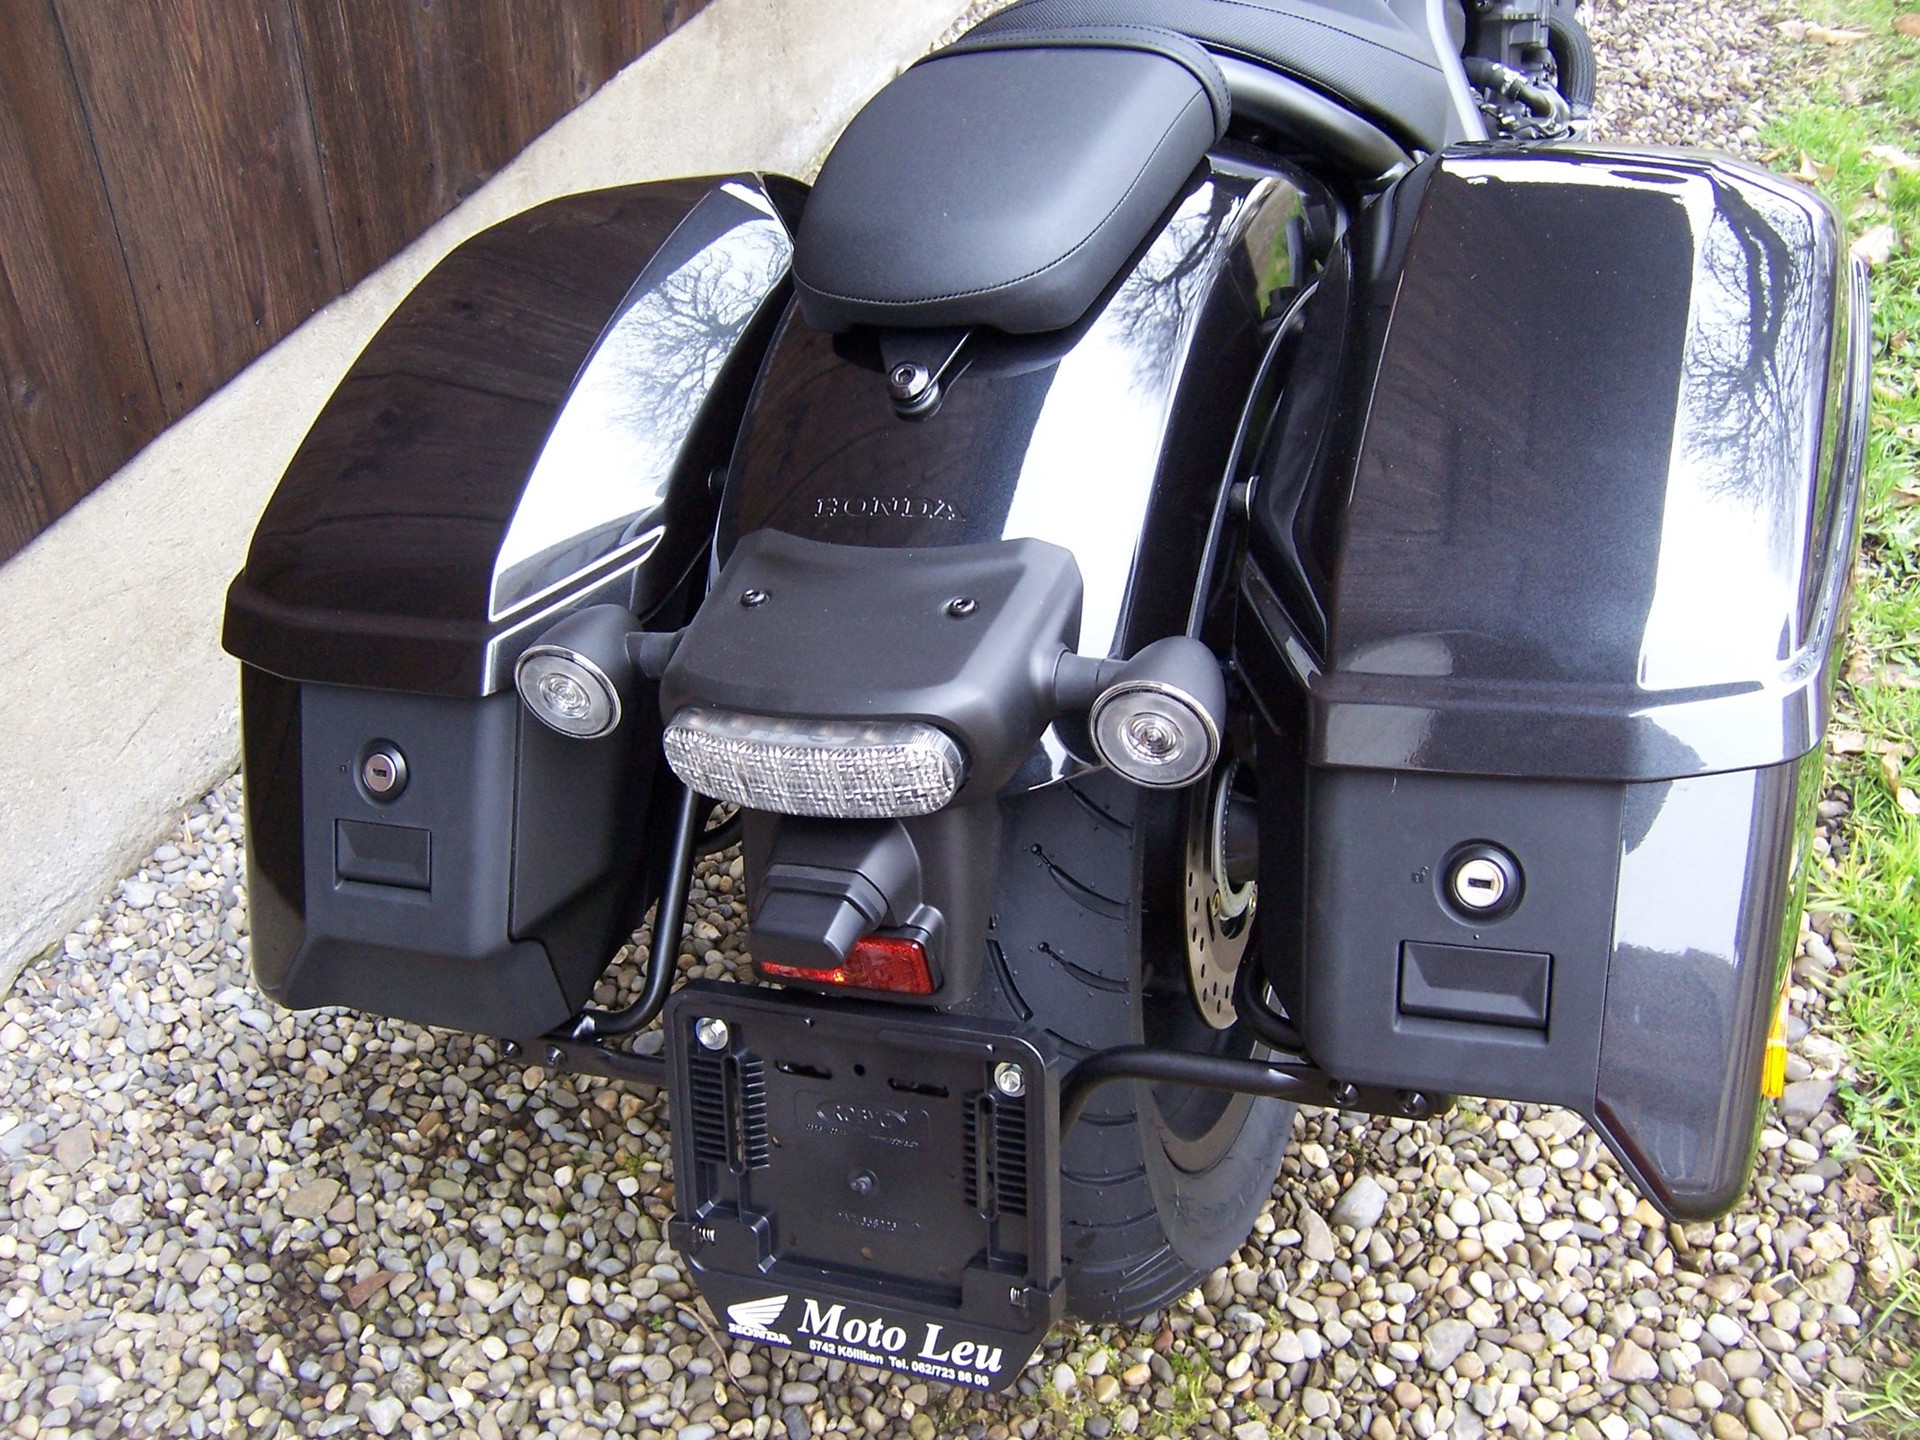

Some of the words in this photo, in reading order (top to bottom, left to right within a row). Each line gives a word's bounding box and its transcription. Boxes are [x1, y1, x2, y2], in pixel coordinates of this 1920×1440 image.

[814, 497, 967, 522] HONDA
[727, 1322, 792, 1345] HONDA
[797, 1298, 907, 1351] Moto
[918, 1322, 1003, 1373] Leu
[809, 1339, 836, 1355] 5742
[837, 1344, 884, 1365] Kölliken
[888, 1355, 909, 1370] Tel.
[911, 1361, 956, 1380] 062/723
[974, 1374, 990, 1387] 06
